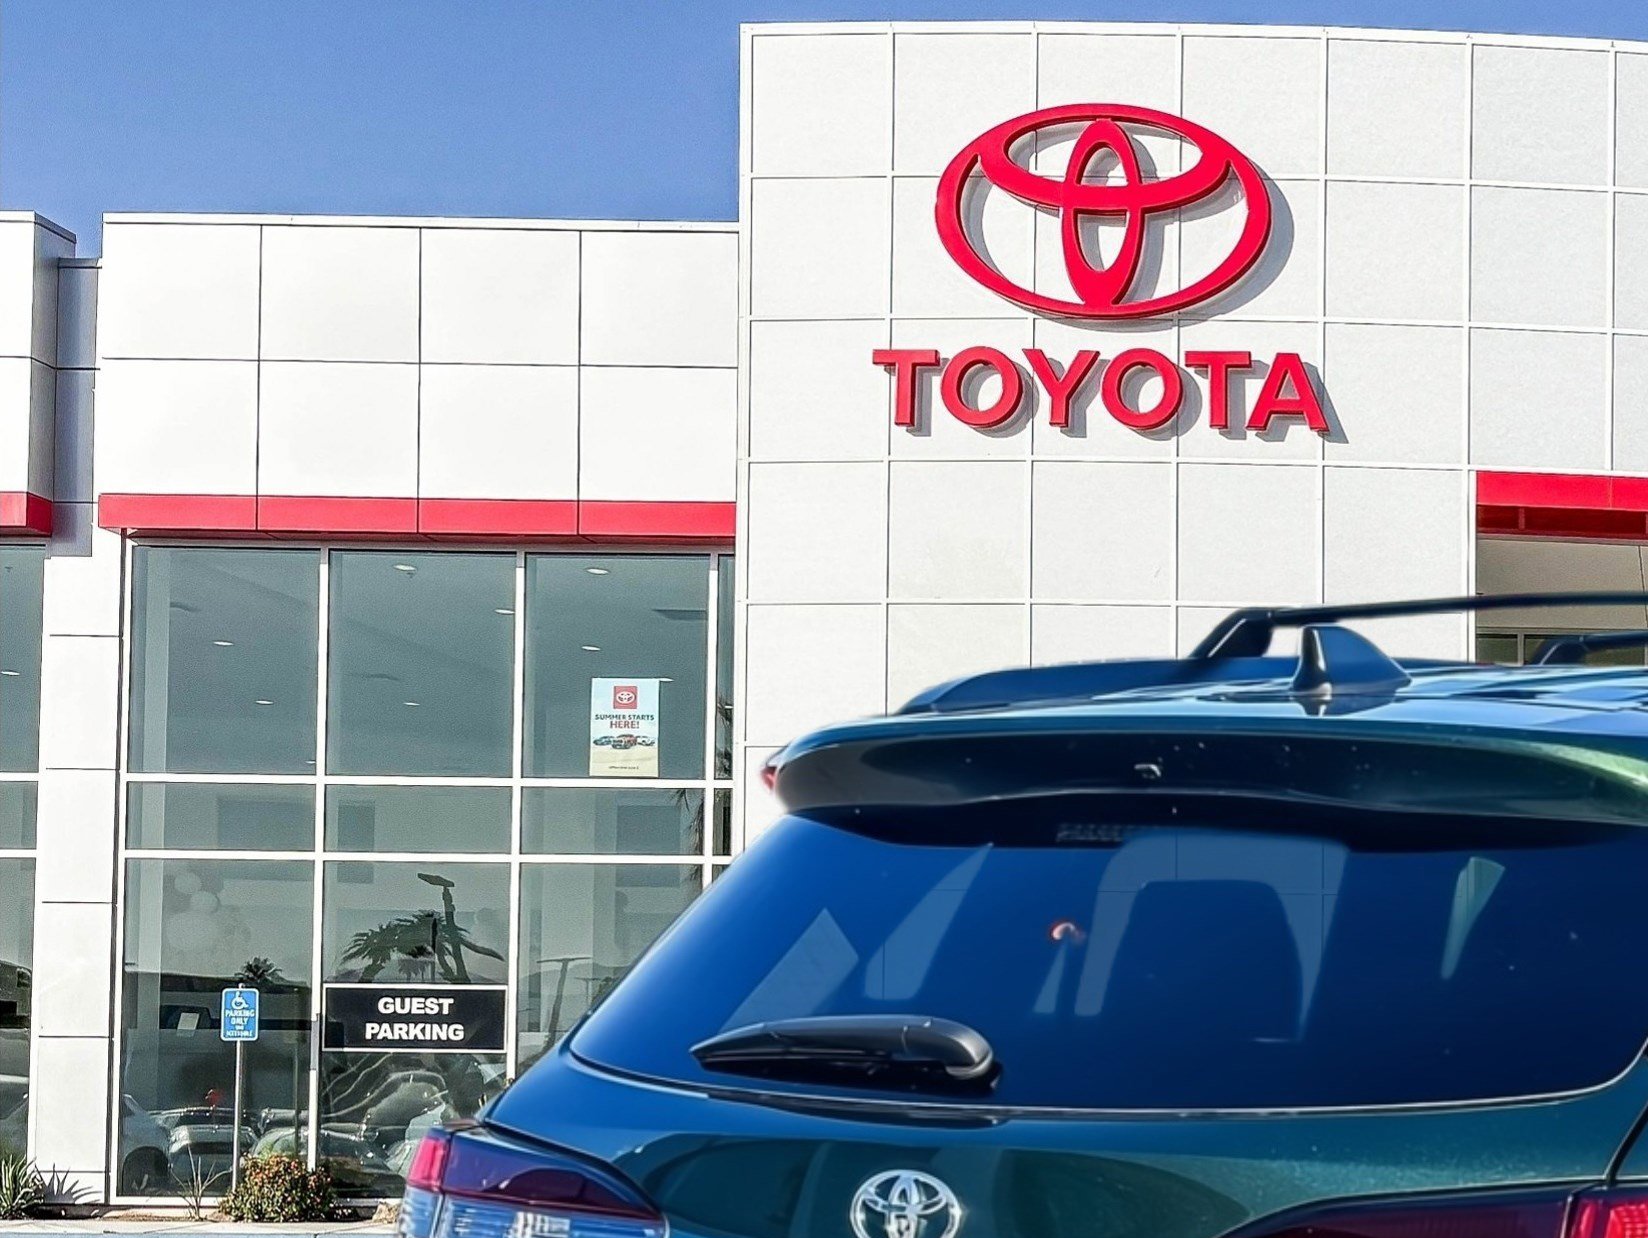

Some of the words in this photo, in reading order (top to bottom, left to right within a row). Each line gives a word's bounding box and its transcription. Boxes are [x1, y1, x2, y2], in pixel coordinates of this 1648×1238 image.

[872, 346, 1330, 432] TOYOTA
[609, 720, 640, 729] HERE!
[224, 1009, 255, 1018] PARKING
[377, 997, 454, 1015] GUEST
[365, 1022, 465, 1041] PARKING
